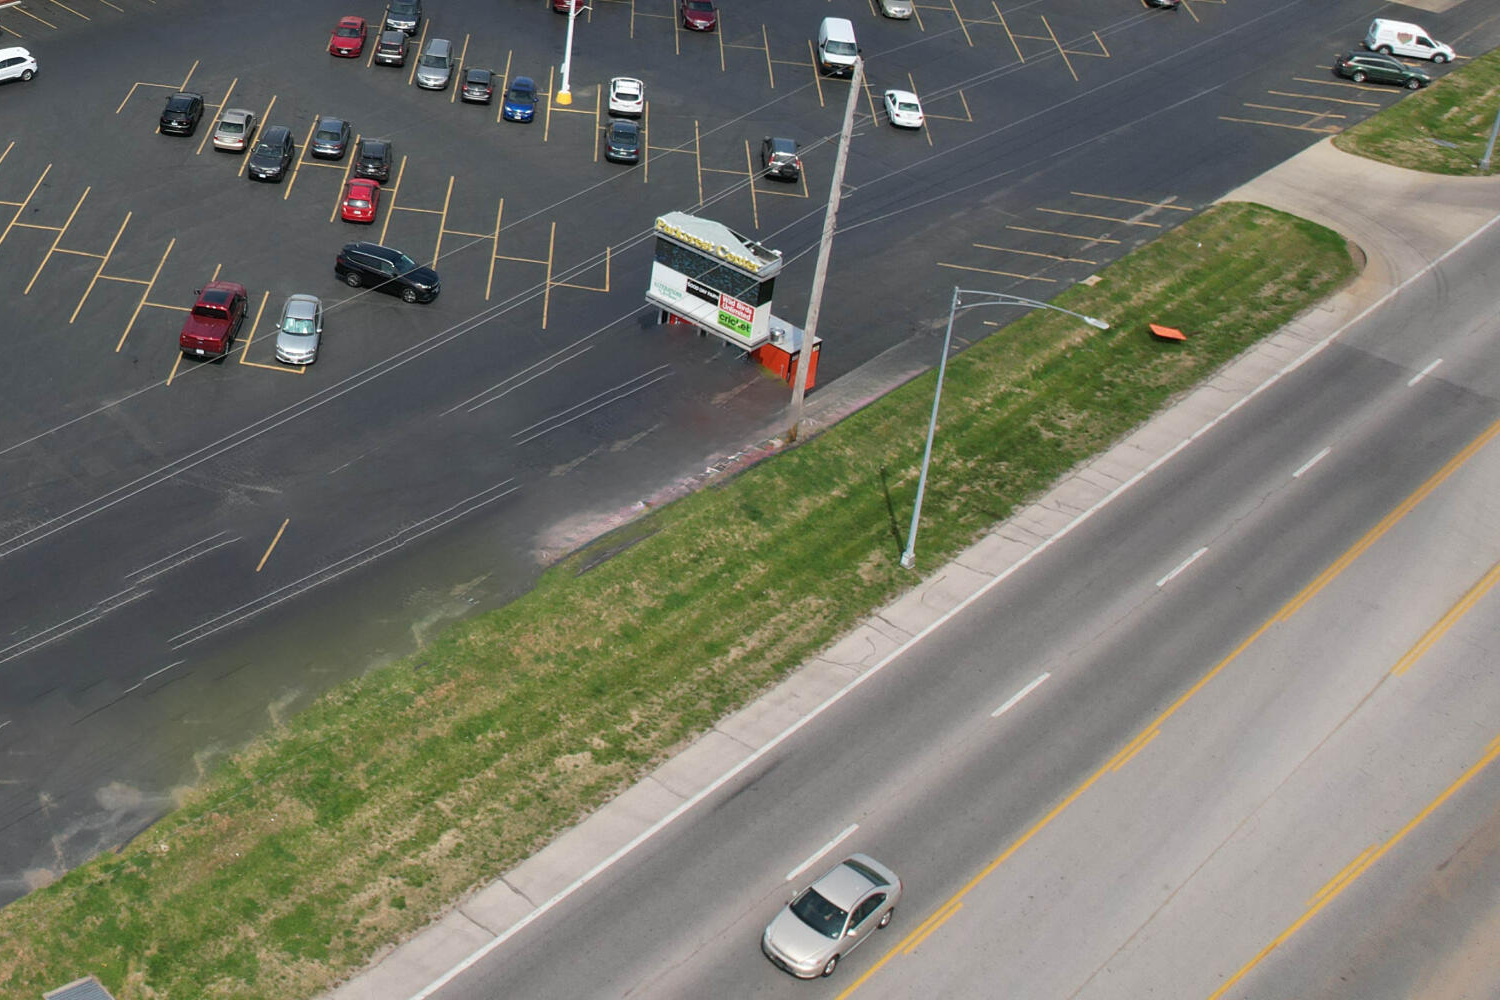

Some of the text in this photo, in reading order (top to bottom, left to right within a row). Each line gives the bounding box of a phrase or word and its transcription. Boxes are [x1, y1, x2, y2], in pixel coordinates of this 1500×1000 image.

[656, 217, 760, 273] Parkcrest Center
[719, 314, 751, 332] cricket
